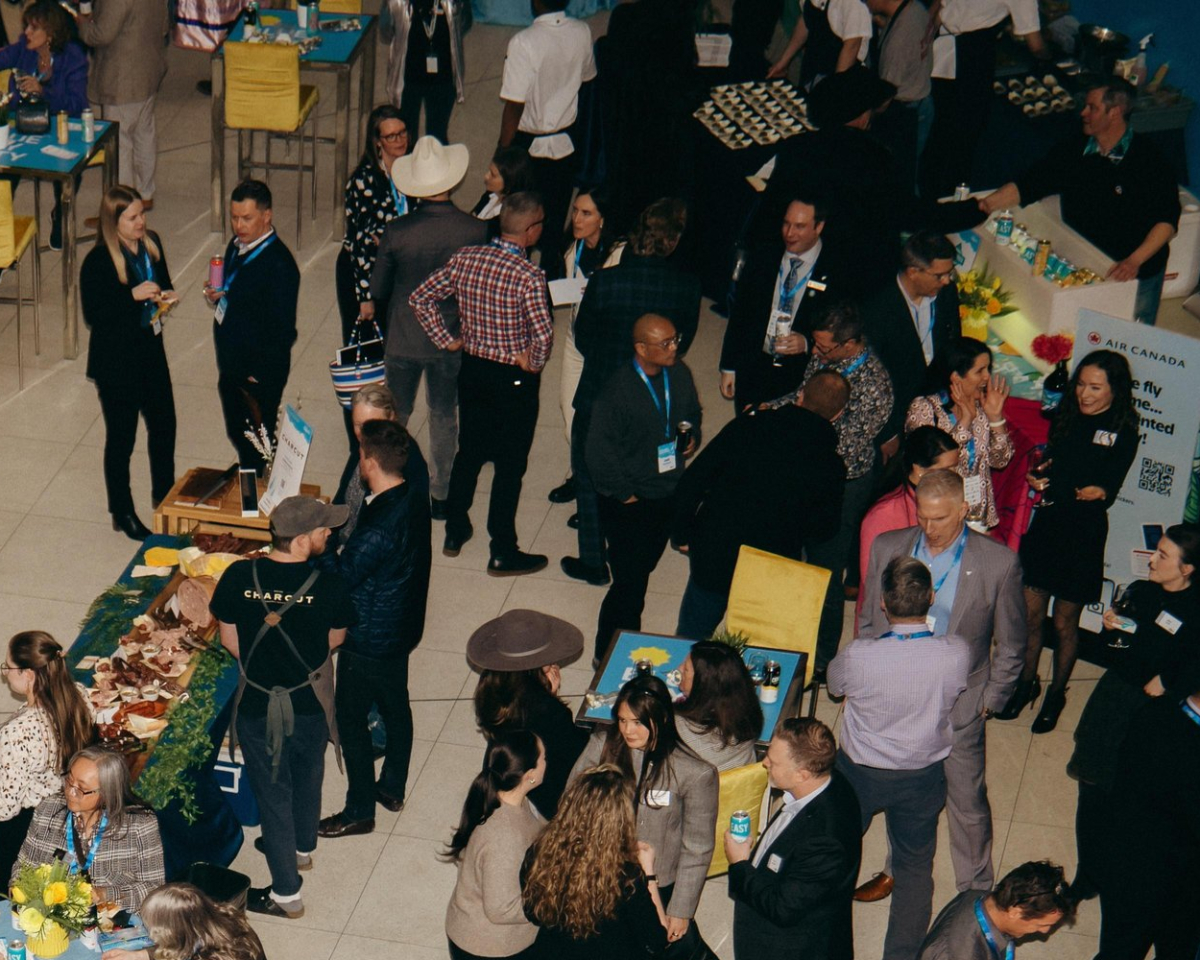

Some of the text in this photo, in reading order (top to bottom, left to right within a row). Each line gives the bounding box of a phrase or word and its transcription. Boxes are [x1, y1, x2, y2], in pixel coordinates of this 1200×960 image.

[1105, 339, 1186, 369] AIR CANADA
[1143, 380, 1162, 398] fly
[1140, 417, 1175, 435] nted
[731, 823, 749, 833] EASY
